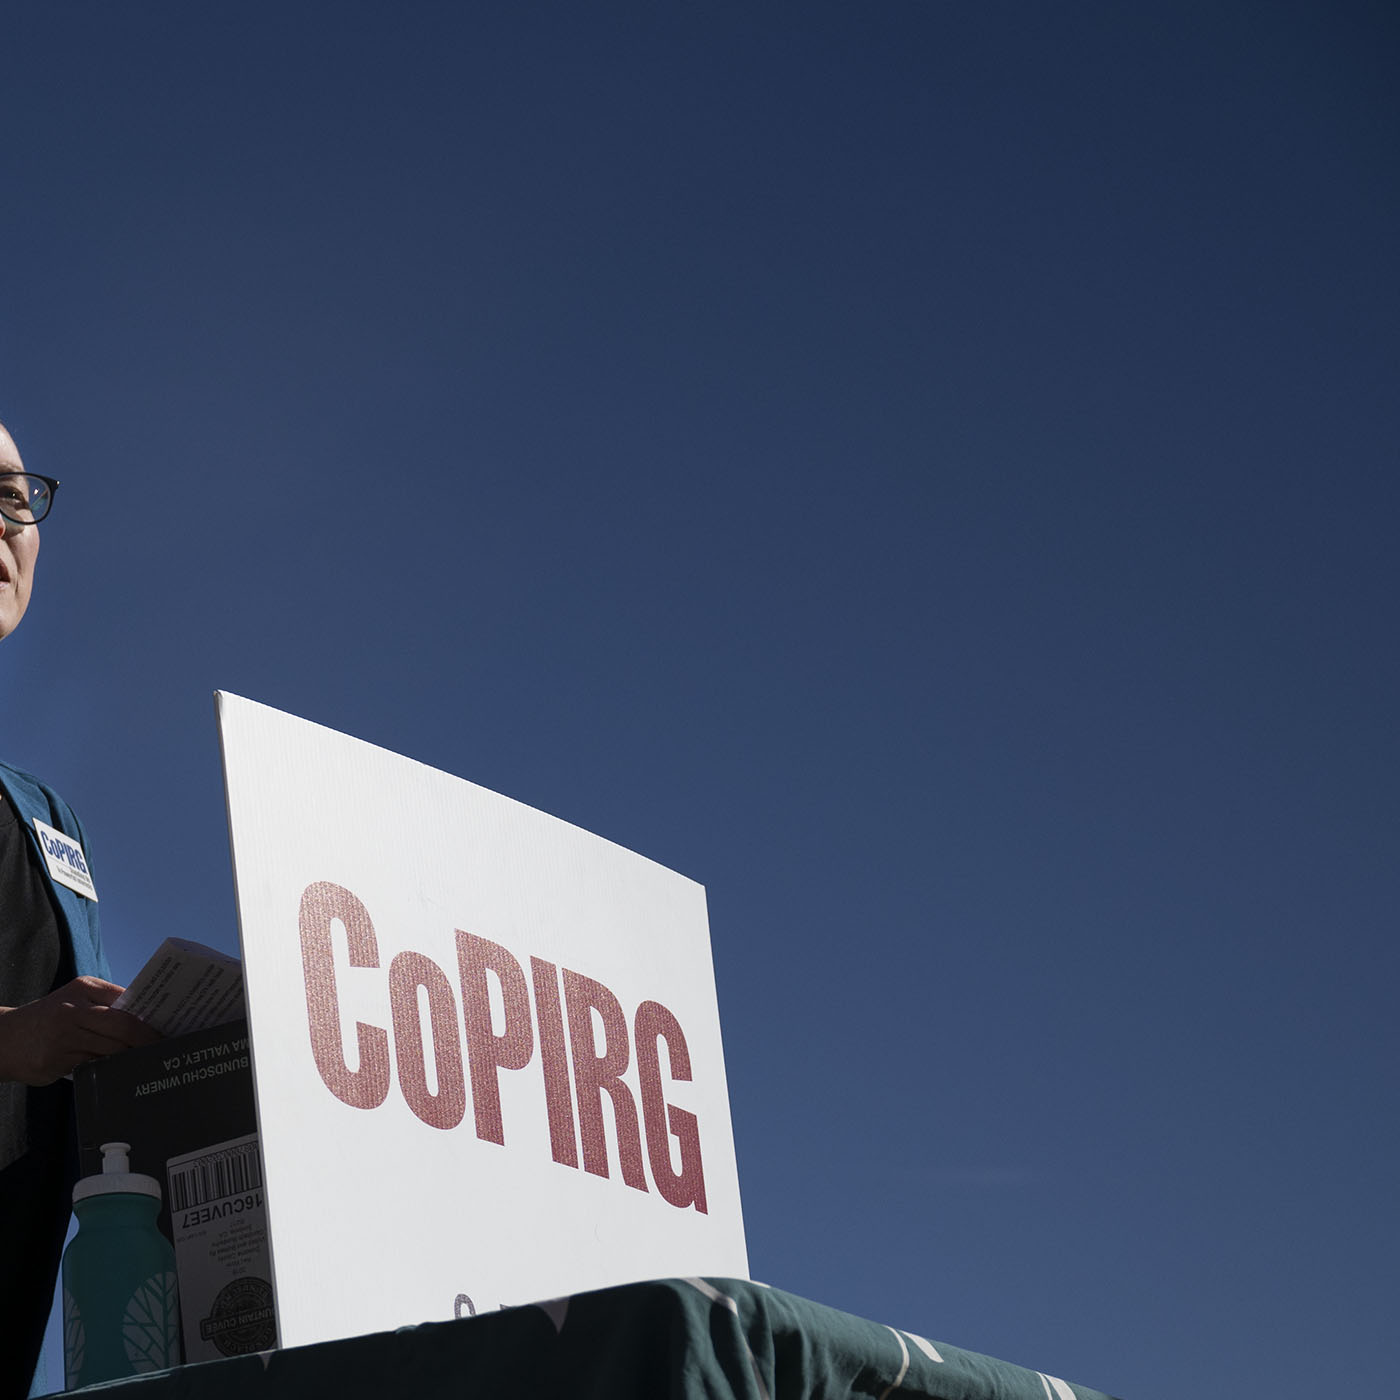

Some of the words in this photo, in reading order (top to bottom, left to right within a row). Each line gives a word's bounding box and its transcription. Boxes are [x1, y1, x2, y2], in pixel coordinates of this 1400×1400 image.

[40, 830, 88, 875] CoPIRG
[182, 1043, 230, 1066] VALLEY,
[299, 881, 709, 1215] CoPIRG
[162, 1056, 181, 1071] CA
[182, 1056, 249, 1085] BUNDSCHU
[135, 1075, 181, 1097] WINERY
[182, 1193, 263, 1229] 16CUVEE7
